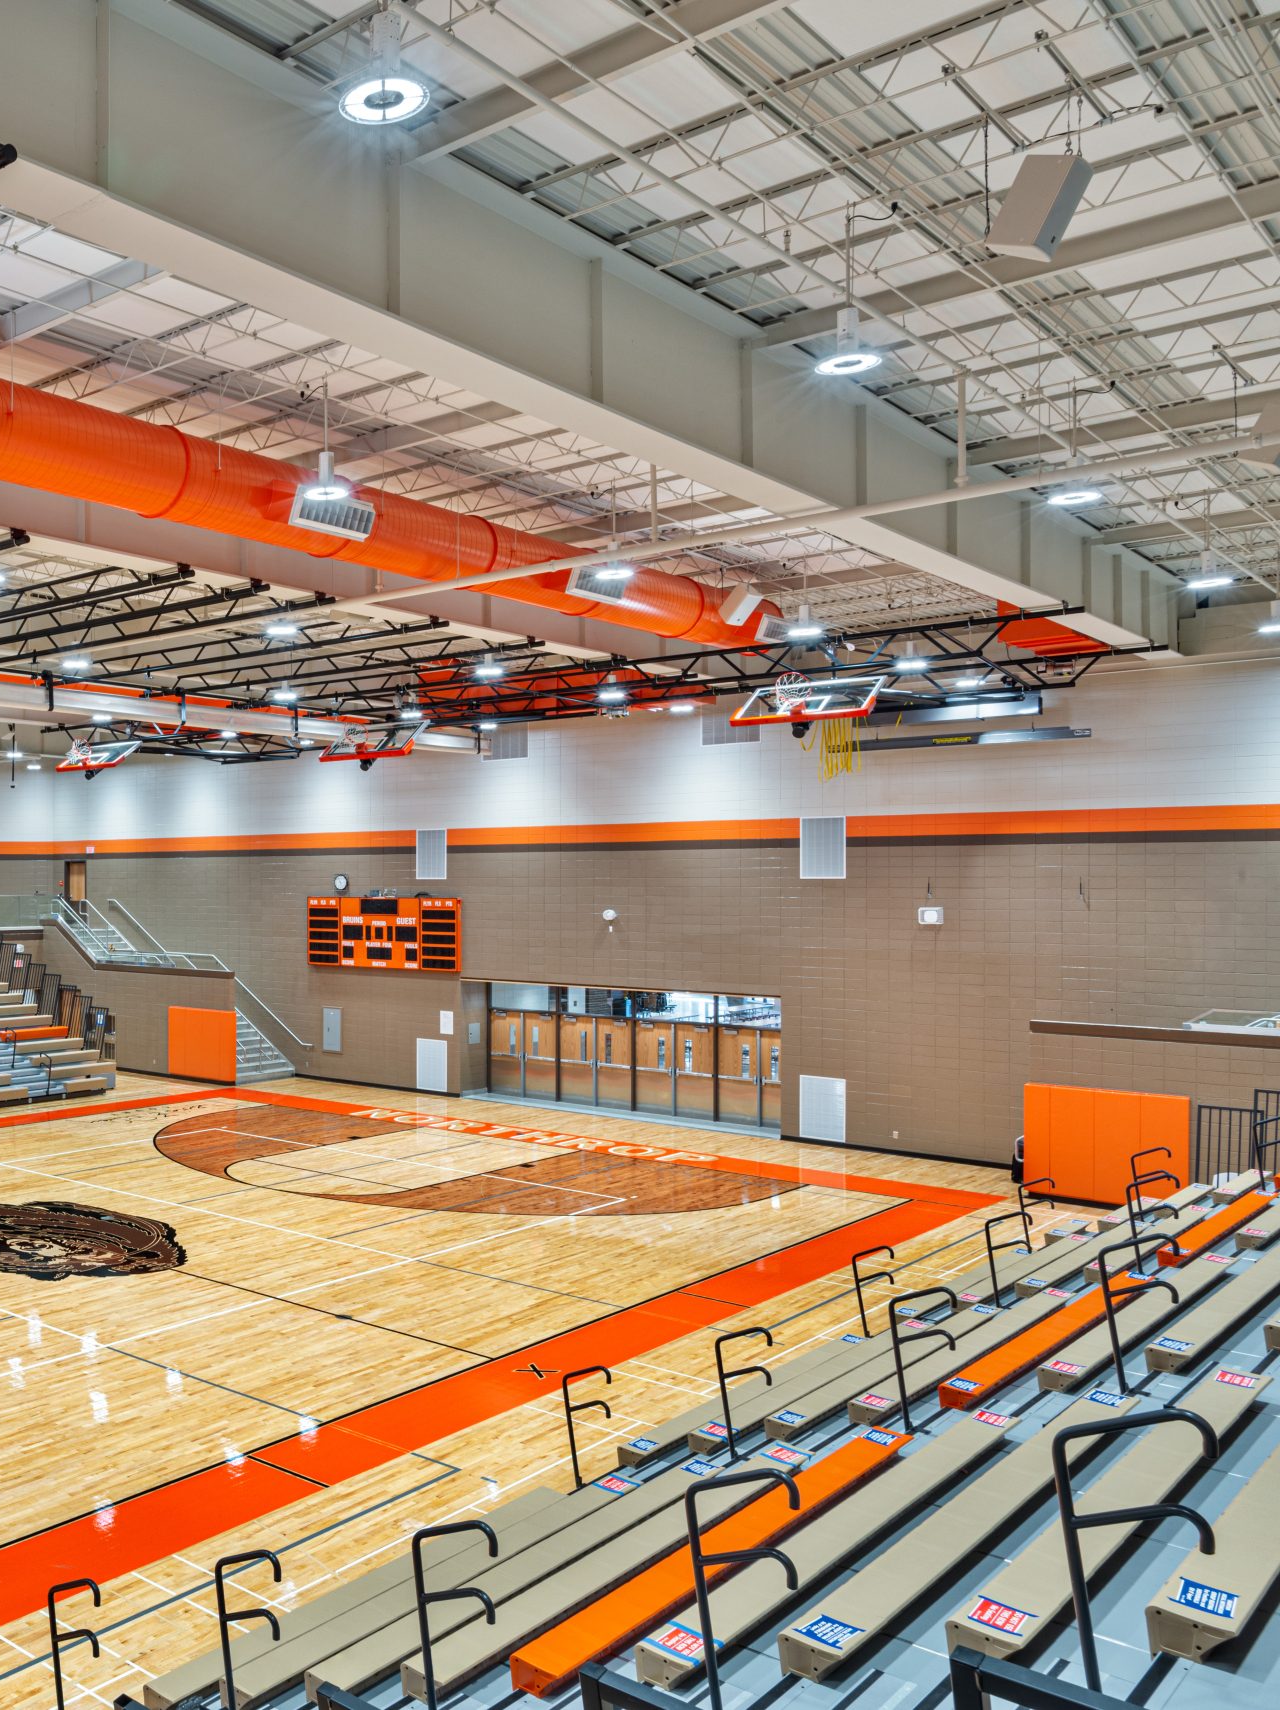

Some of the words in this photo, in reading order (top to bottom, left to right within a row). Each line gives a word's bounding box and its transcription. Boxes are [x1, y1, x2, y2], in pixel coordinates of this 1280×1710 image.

[342, 916, 363, 924] BRUINS
[396, 917, 416, 925] GUEST
[349, 1108, 720, 1163] NORTHROP
